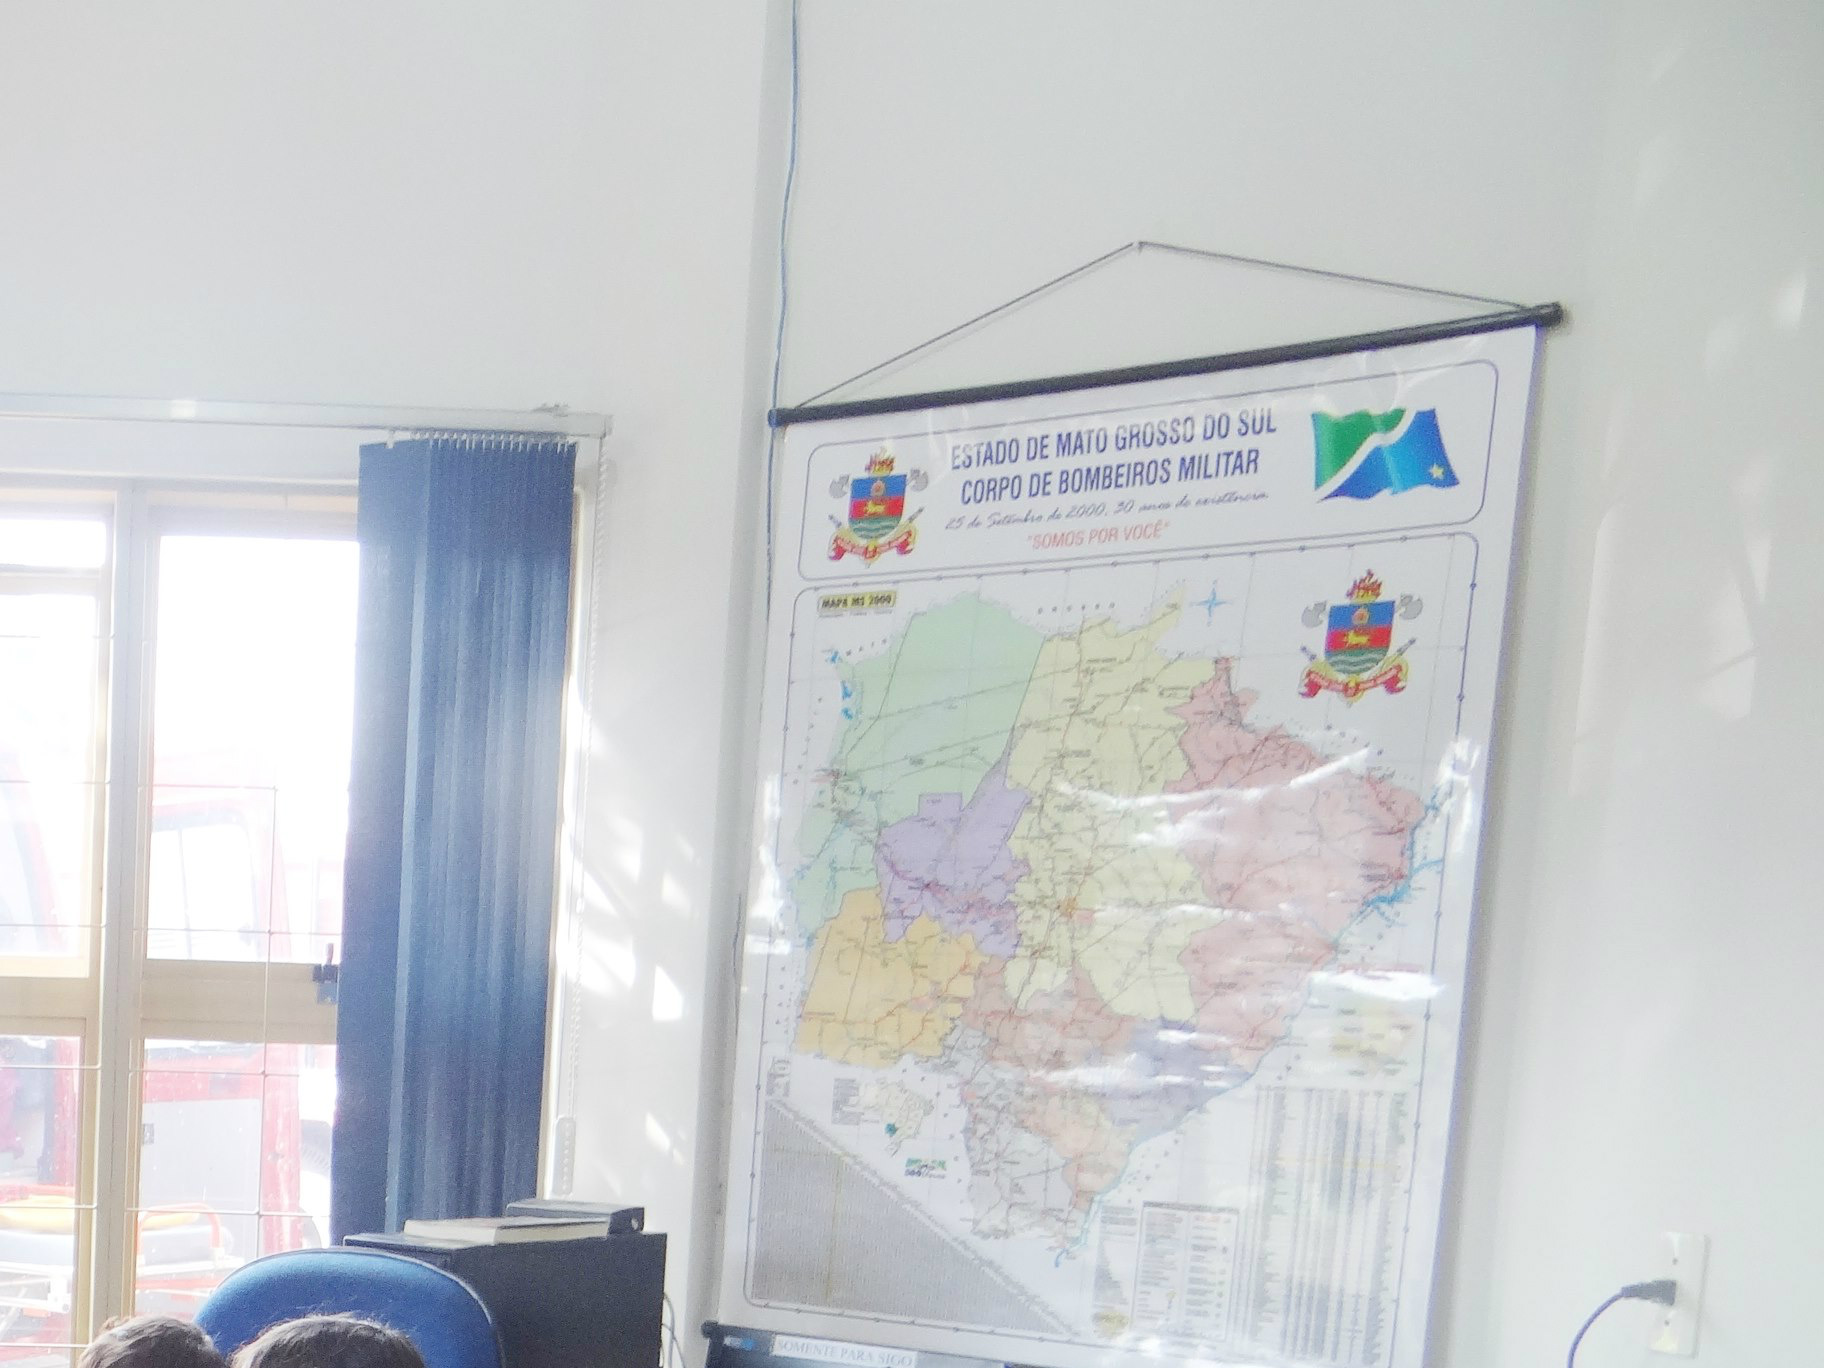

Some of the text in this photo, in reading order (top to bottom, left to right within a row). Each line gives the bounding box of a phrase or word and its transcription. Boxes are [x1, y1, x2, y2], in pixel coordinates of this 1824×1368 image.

[951, 407, 1277, 470] ESTADO DE MATO GROSSO DO SUL
[961, 448, 1260, 505] CORPO DE BOMBEIROS MILITAR
[945, 515, 965, 530] 25
[967, 516, 982, 530] de
[1047, 506, 1062, 522] de
[1113, 500, 1135, 514] 30
[1088, 527, 1119, 545] POR
[778, 1337, 913, 1368] SOMENTE PARA SIGO
